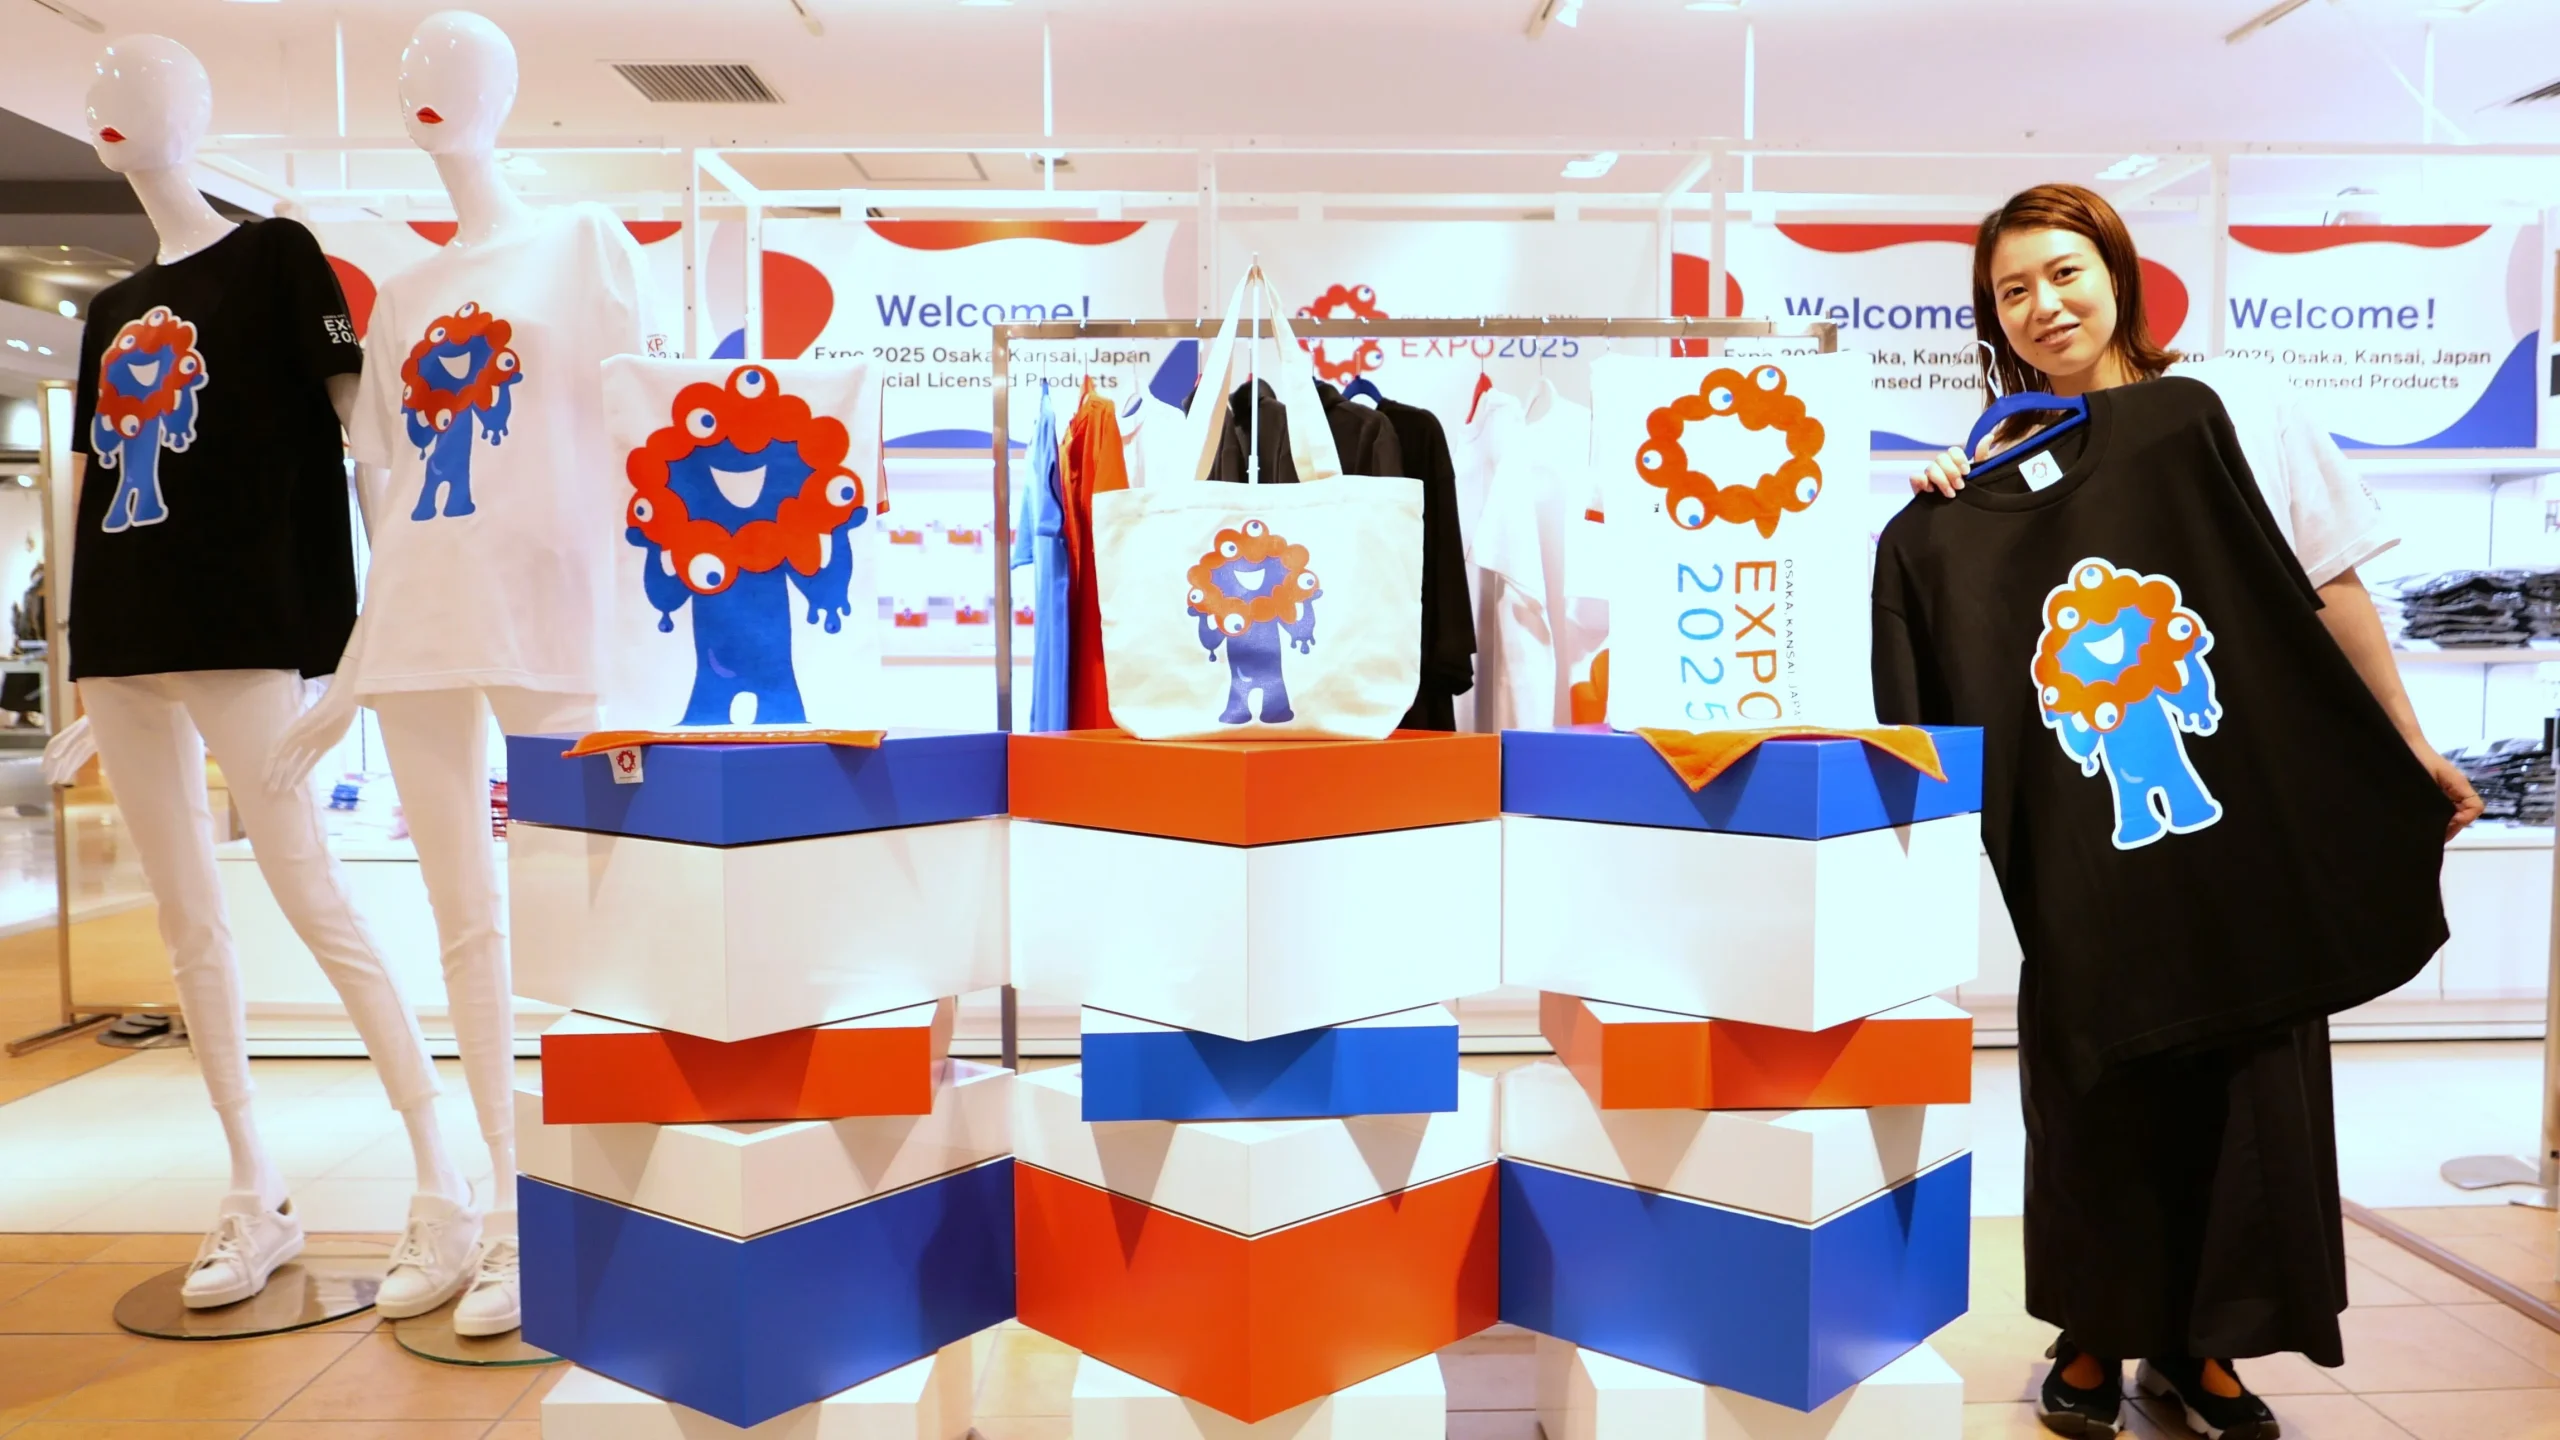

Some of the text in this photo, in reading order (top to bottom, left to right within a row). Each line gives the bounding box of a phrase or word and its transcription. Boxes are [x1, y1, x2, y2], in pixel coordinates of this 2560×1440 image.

[876, 295, 1090, 328] Welcome!
[1785, 297, 1976, 329] Welcome
[2229, 298, 2435, 329] Welcome!
[873, 347, 926, 362] 2025
[933, 347, 993, 363] Osaka
[1090, 348, 1151, 366] Japan
[2282, 349, 2347, 366] Osaka,
[2355, 349, 2425, 366] Kansai,
[2432, 349, 2491, 367] Japan
[928, 372, 1017, 388] Licensd
[2371, 374, 2459, 389] Products
[1677, 563, 1729, 721] 2025
